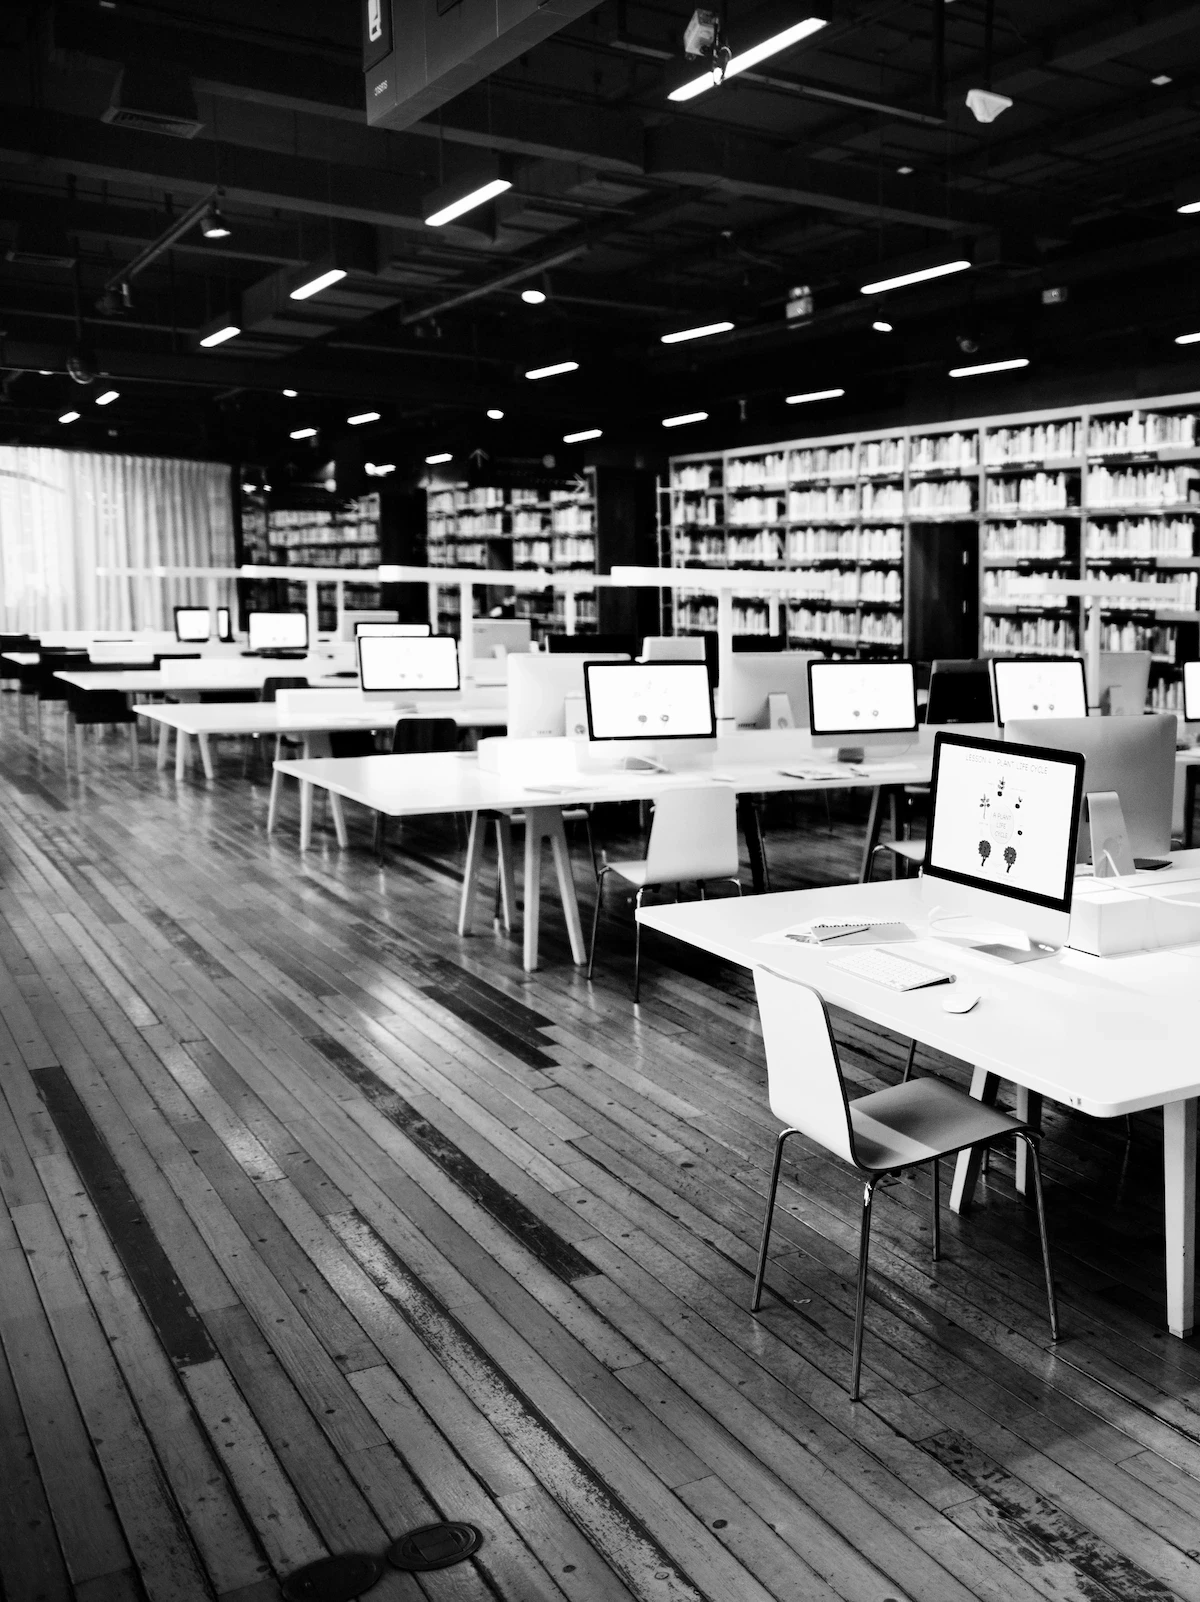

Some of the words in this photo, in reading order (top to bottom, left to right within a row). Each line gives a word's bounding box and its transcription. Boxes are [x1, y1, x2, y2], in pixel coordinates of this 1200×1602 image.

[965, 753, 987, 765] LESSON
[996, 758, 1015, 770] PLANT
[1016, 762, 1029, 772] LIFE
[1030, 764, 1049, 775] CYCLE
[997, 812, 1012, 820] PLANT
[996, 822, 1007, 830] LIFE
[994, 830, 1008, 839] CYCLE
